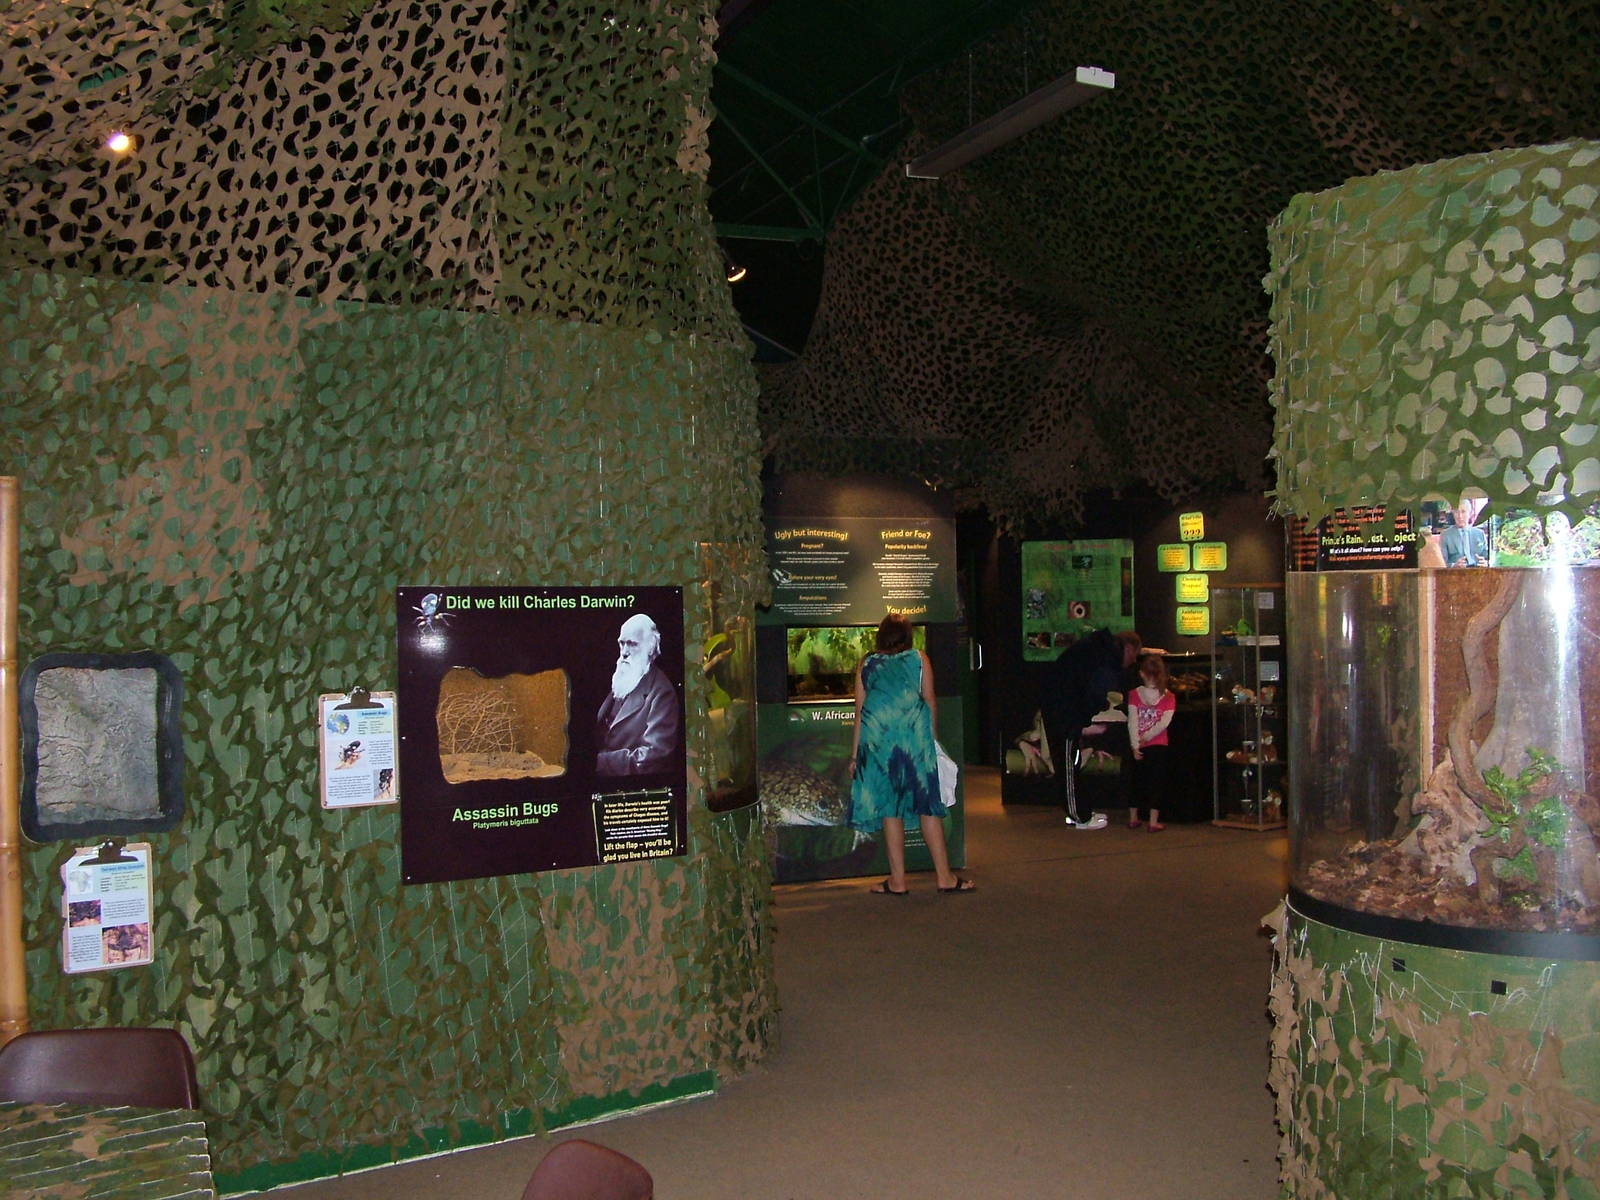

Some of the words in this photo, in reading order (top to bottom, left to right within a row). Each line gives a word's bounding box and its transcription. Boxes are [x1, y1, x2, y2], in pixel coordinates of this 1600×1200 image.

[775, 531, 791, 540] Ugly
[793, 529, 806, 537] but
[807, 529, 848, 541] interesting!
[882, 530, 903, 539] Friend
[914, 530, 931, 539] Foe?
[446, 596, 470, 609] Did
[477, 598, 495, 608] we
[500, 596, 519, 608] kill
[524, 595, 576, 608] Charles
[581, 595, 635, 608] Darwin?
[887, 605, 900, 614] You
[902, 604, 926, 614] decide!
[812, 712, 822, 720] W.
[825, 711, 855, 720] African
[452, 804, 518, 821] Assassin
[523, 802, 558, 816] Bugs
[473, 820, 508, 829] Platymeris
[510, 818, 539, 827] biguttata
[604, 842, 614, 850] Lift
[626, 841, 638, 849] flap
[645, 839, 663, 848] you'll
[603, 853, 616, 862] glad
